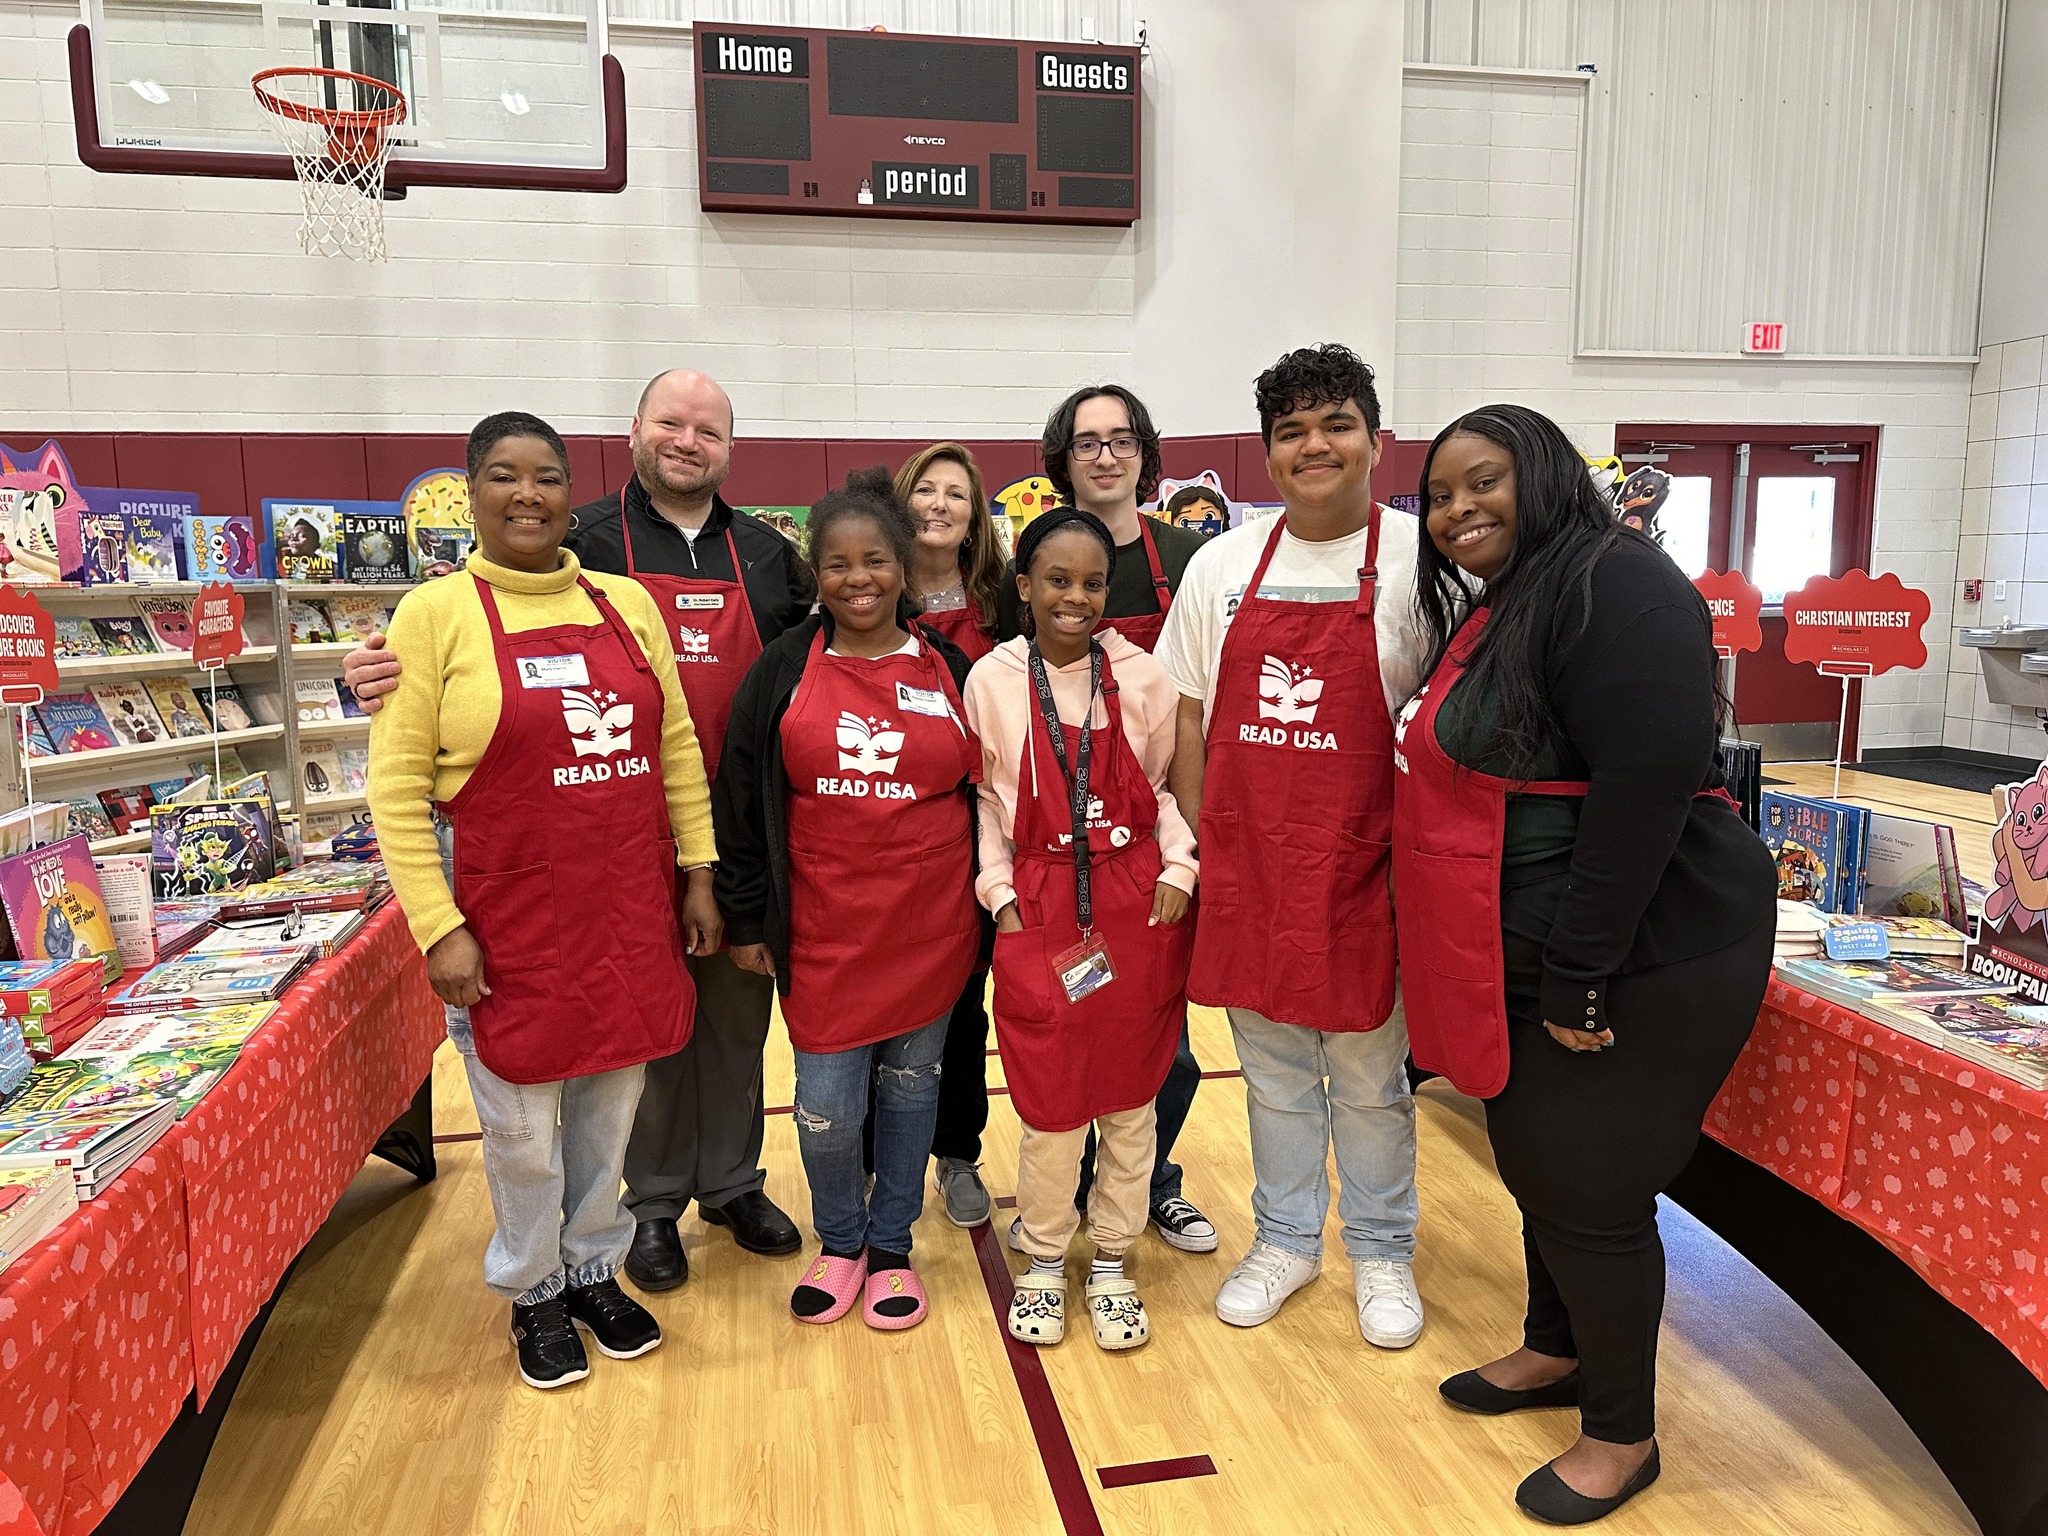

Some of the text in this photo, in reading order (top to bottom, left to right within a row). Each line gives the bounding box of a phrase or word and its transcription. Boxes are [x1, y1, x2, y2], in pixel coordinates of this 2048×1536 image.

[718, 37, 793, 73] Home
[1042, 55, 1128, 90] Guests
[886, 167, 966, 199] period
[1752, 324, 1782, 350] EXIT
[131, 516, 151, 527] Dear
[346, 519, 406, 534] EARTH!
[282, 555, 333, 570] CROWN
[204, 599, 229, 618] FAVORITE
[345, 601, 370, 614] GREAT
[1707, 599, 1735, 617] ENCE
[0, 614, 36, 635] DCOVER
[199, 615, 234, 636] CHARACTERS
[1796, 610, 1911, 628] CHRISTIAN INTEREST
[16, 639, 45, 657] BOOKS
[675, 654, 719, 663] READ USA
[296, 681, 334, 692] UNICORN
[1030, 656, 1052, 699] 2024
[98, 689, 142, 698] Ruby Bridges
[50, 709, 97, 722] MERMAIDS
[1045, 711, 1064, 756] 2024
[1239, 724, 1339, 751] READ USA
[553, 756, 650, 787] READ USA
[816, 777, 917, 800] READ USA
[1075, 768, 1088, 813] 2024
[185, 811, 236, 824] SPIDEY
[1770, 807, 1781, 816] POP
[1772, 815, 1781, 825] UP
[1095, 820, 1112, 828] USA
[1880, 835, 1893, 843] GOD
[34, 867, 68, 908] LOVE
[1078, 870, 1090, 915] 2024
[68, 903, 83, 915] really
[73, 905, 97, 926] soft pillow!
[1833, 927, 1878, 937] Squish
[1998, 950, 2047, 977] SCHOLASTIC
[1972, 953, 2019, 986] BOOK
[2017, 973, 2048, 1004] FAI
[31, 996, 48, 1008] K
[24, 1020, 39, 1032] K
[33, 1042, 49, 1052] K
